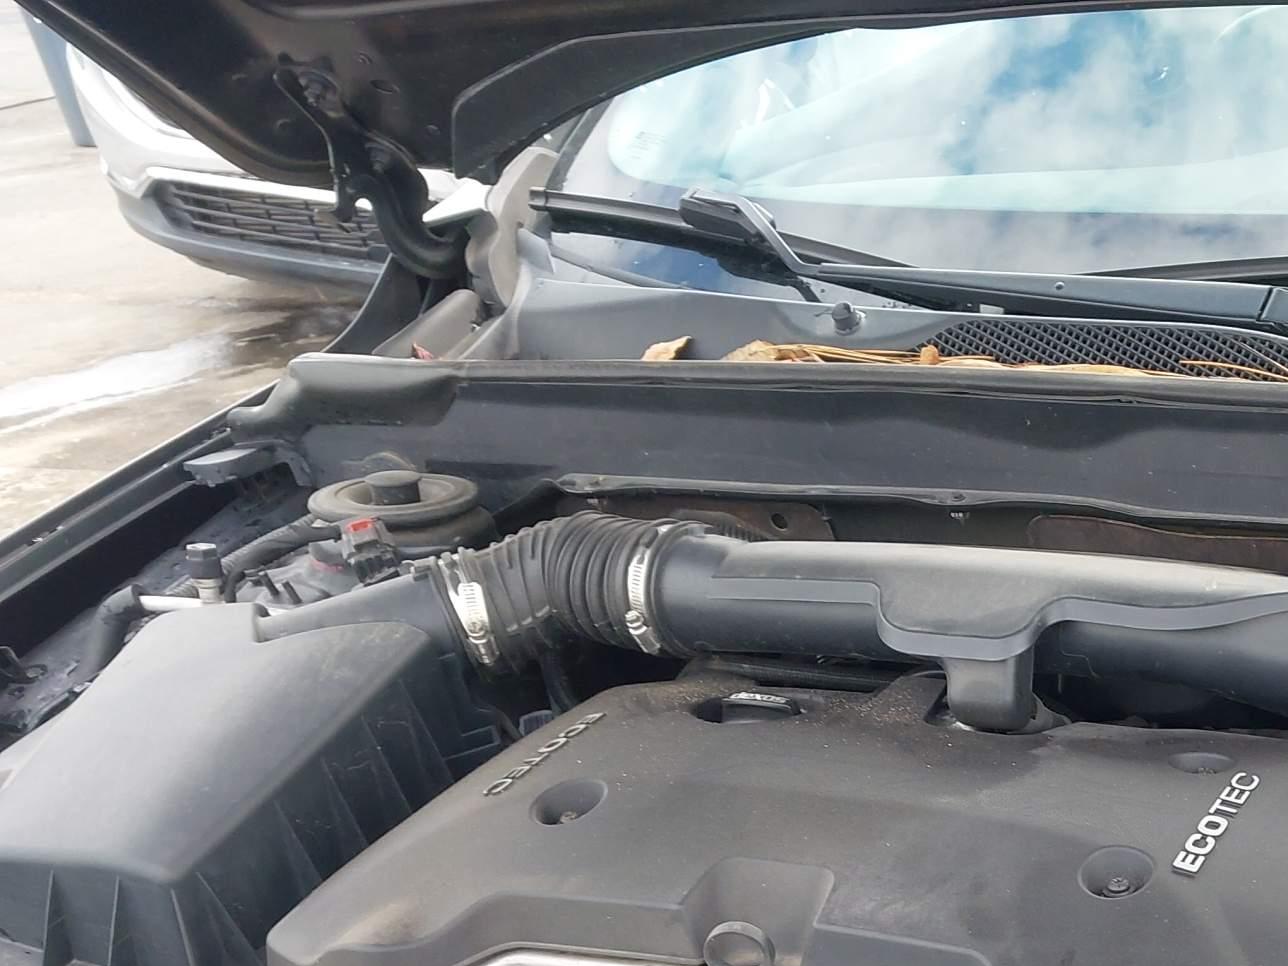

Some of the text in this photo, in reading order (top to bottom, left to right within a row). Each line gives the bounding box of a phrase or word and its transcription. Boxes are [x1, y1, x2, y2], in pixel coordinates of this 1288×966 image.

[729, 692, 790, 704] dexos
[482, 713, 606, 797] ECOTEC
[1172, 771, 1262, 875] ECOTEC
